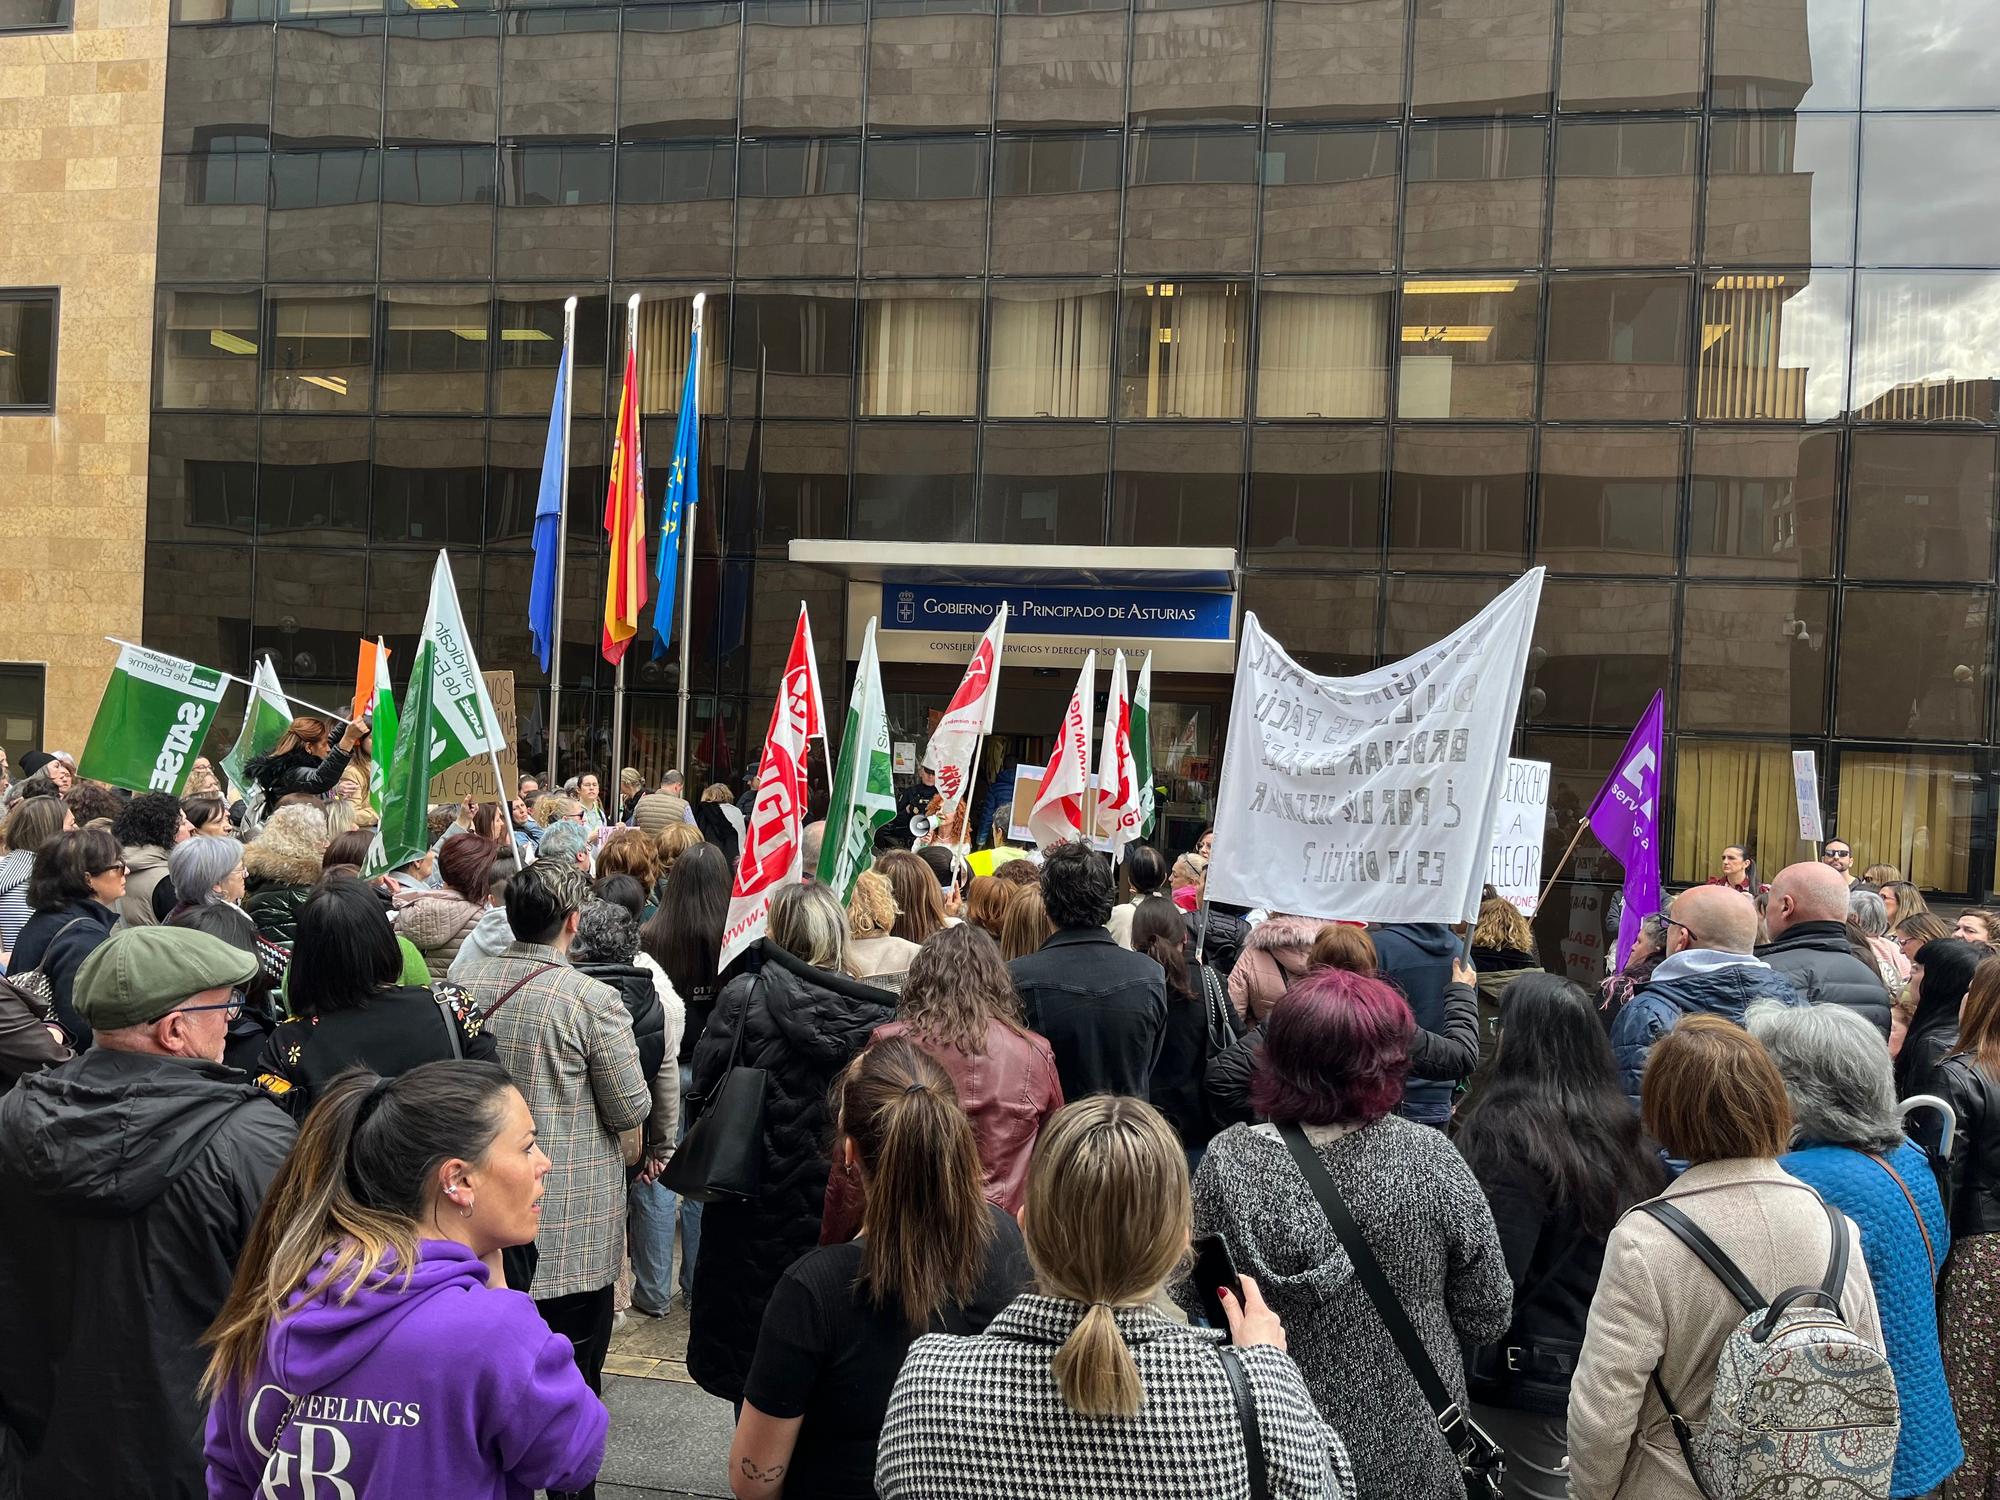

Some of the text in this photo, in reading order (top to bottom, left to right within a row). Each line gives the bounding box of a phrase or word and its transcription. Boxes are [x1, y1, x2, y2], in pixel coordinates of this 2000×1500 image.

[923, 598, 993, 616] GOBIERNO
[1022, 601, 1105, 619] PRINCIPADO
[1109, 607, 1125, 619] DE
[1127, 603, 1196, 621] ASTURIAS
[930, 641, 976, 652] CONSEJERÍ
[1003, 645, 1042, 653] ERVICIOS
[1045, 646, 1050, 654] Y
[1102, 648, 1145, 657] SOALES
[454, 770, 501, 797] ESPALD
[1509, 813, 1522, 834] A
